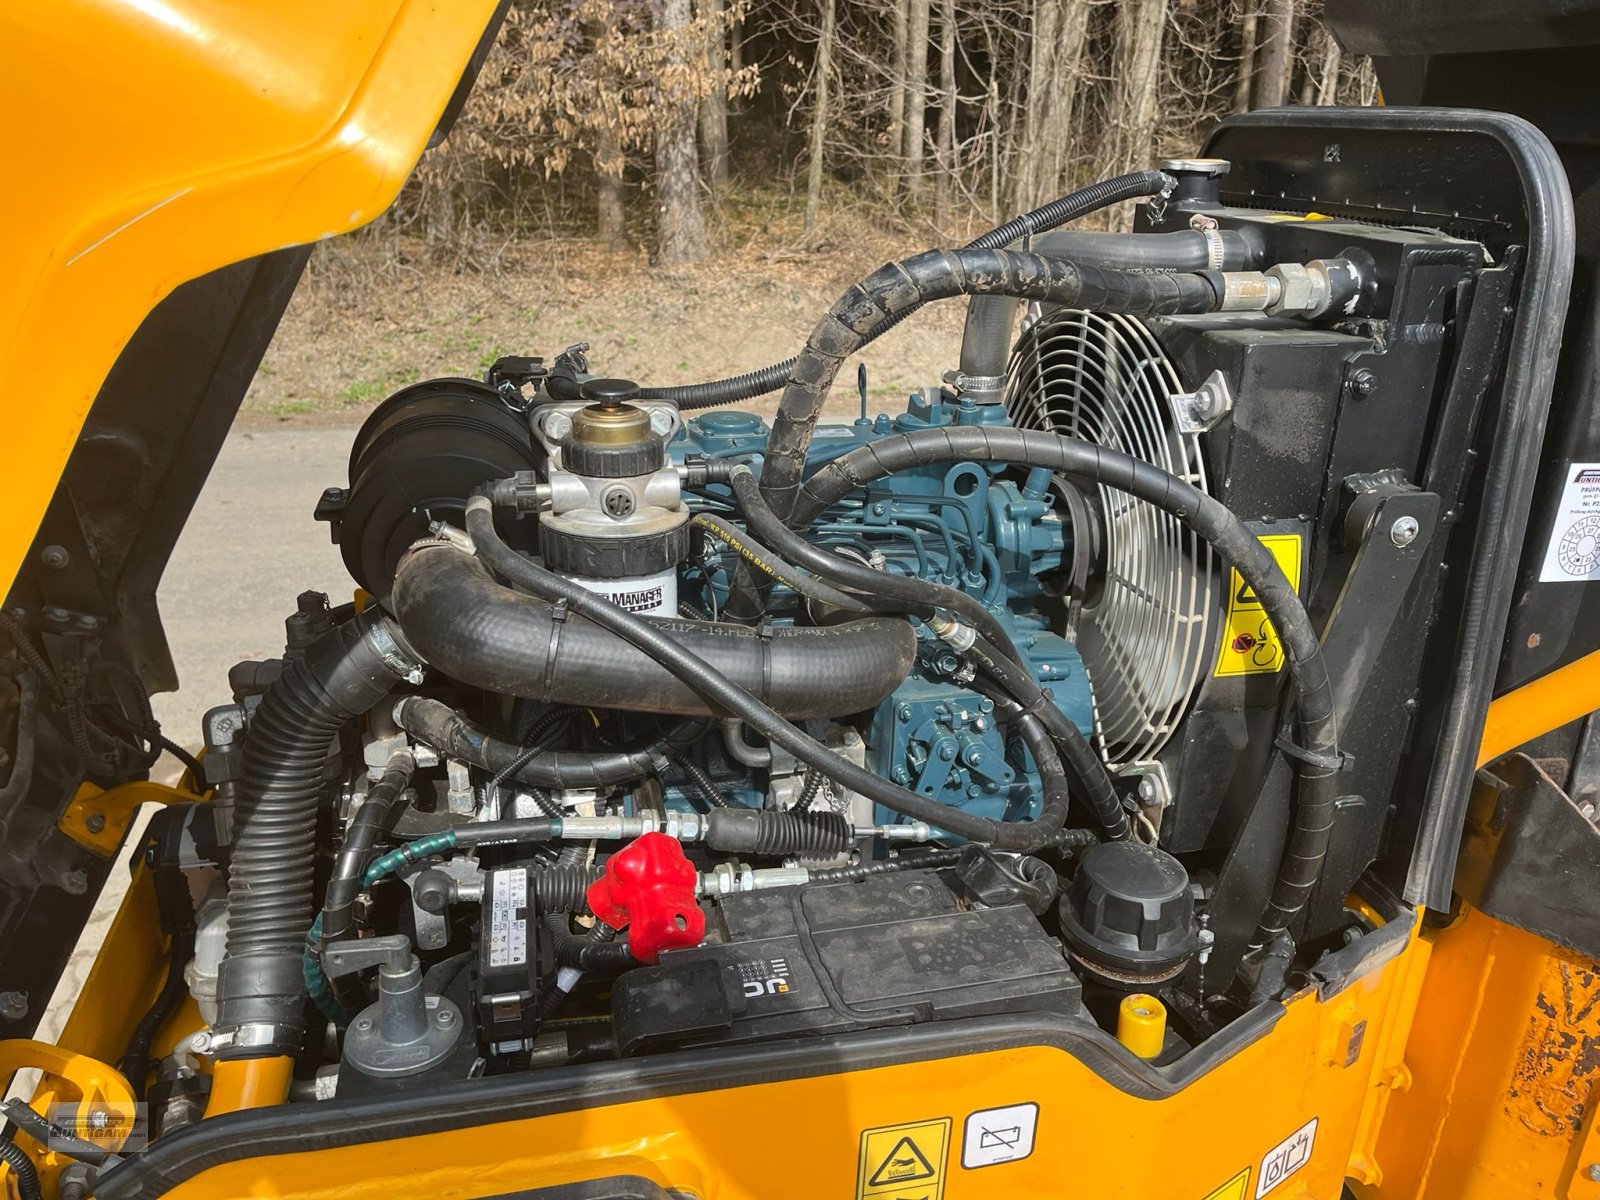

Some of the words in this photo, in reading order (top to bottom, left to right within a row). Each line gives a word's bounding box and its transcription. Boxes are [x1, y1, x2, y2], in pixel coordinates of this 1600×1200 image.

[730, 538, 743, 552] PSI
[753, 557, 776, 577] BAR)
[612, 587, 662, 606] MANAGER
